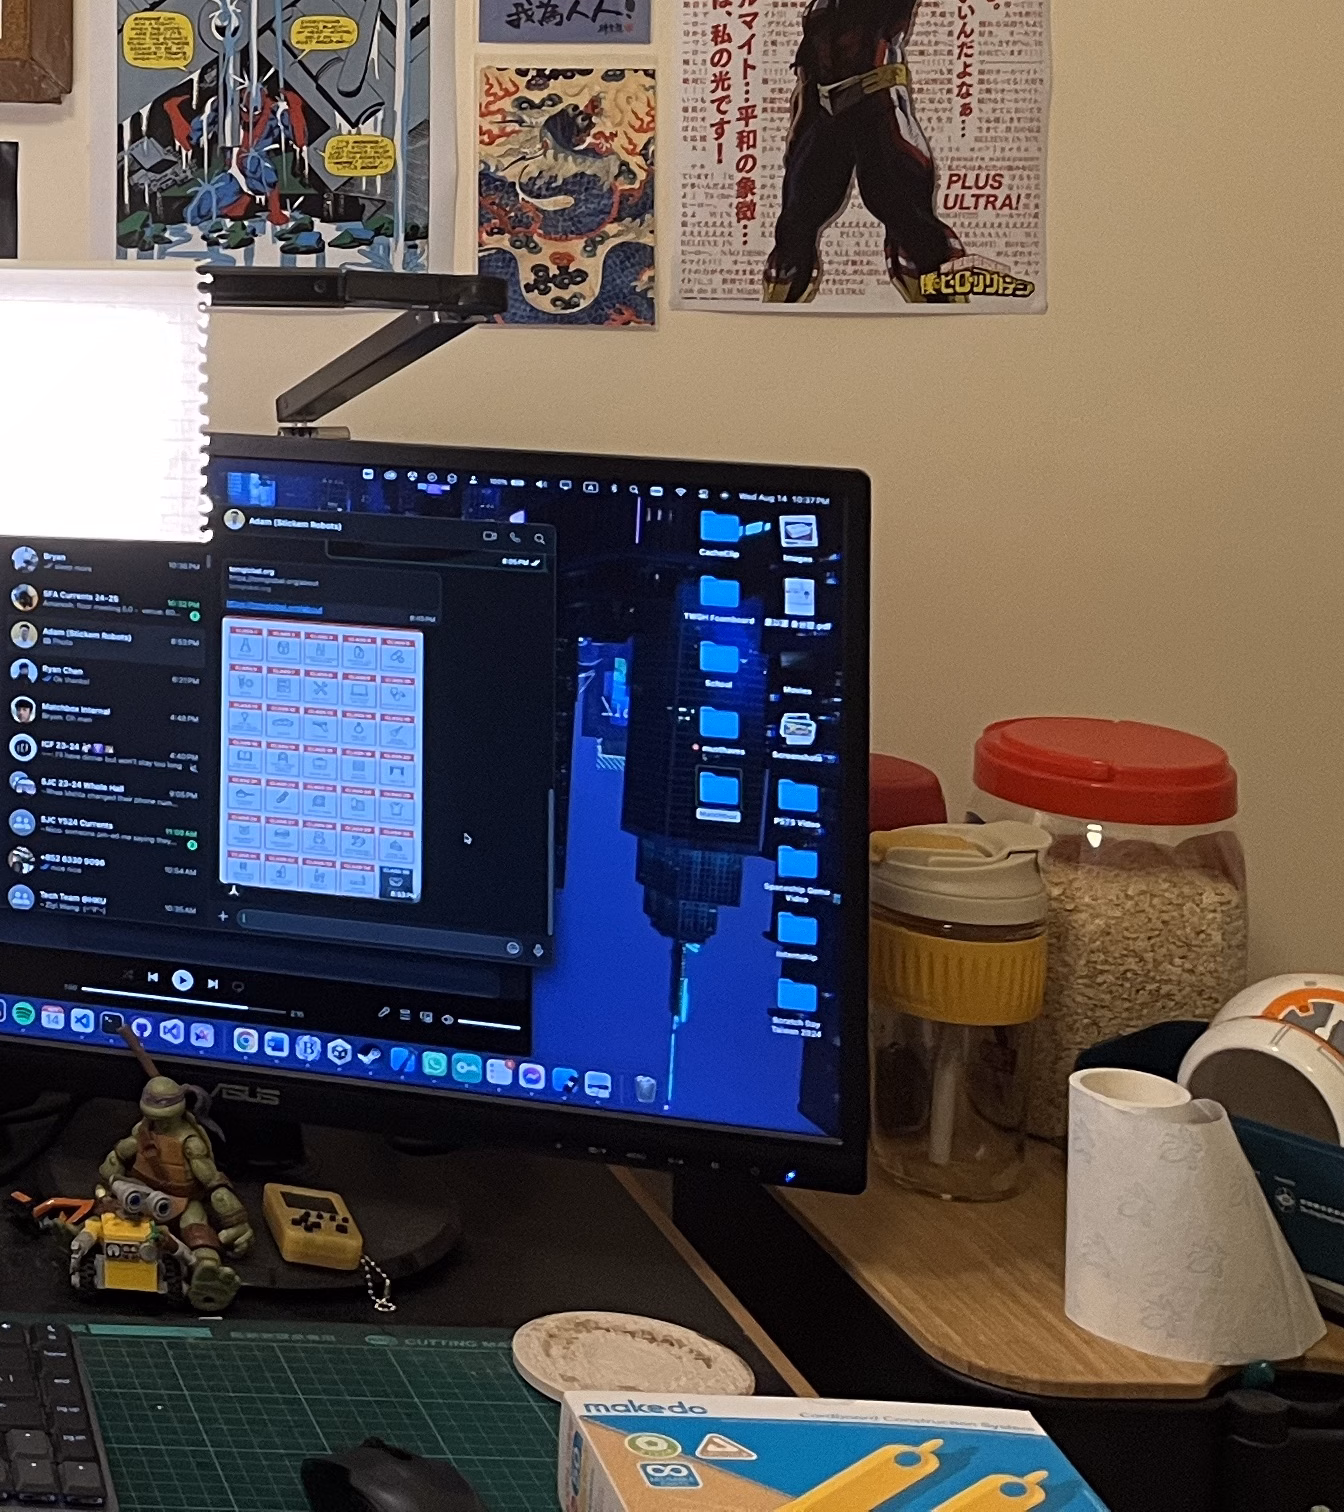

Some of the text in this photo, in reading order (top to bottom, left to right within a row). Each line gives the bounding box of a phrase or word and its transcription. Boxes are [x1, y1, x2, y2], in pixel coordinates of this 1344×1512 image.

[946, 173, 1004, 190] PLUS
[942, 192, 1021, 211] ULTRA!
[583, 1399, 708, 1417] makedo
